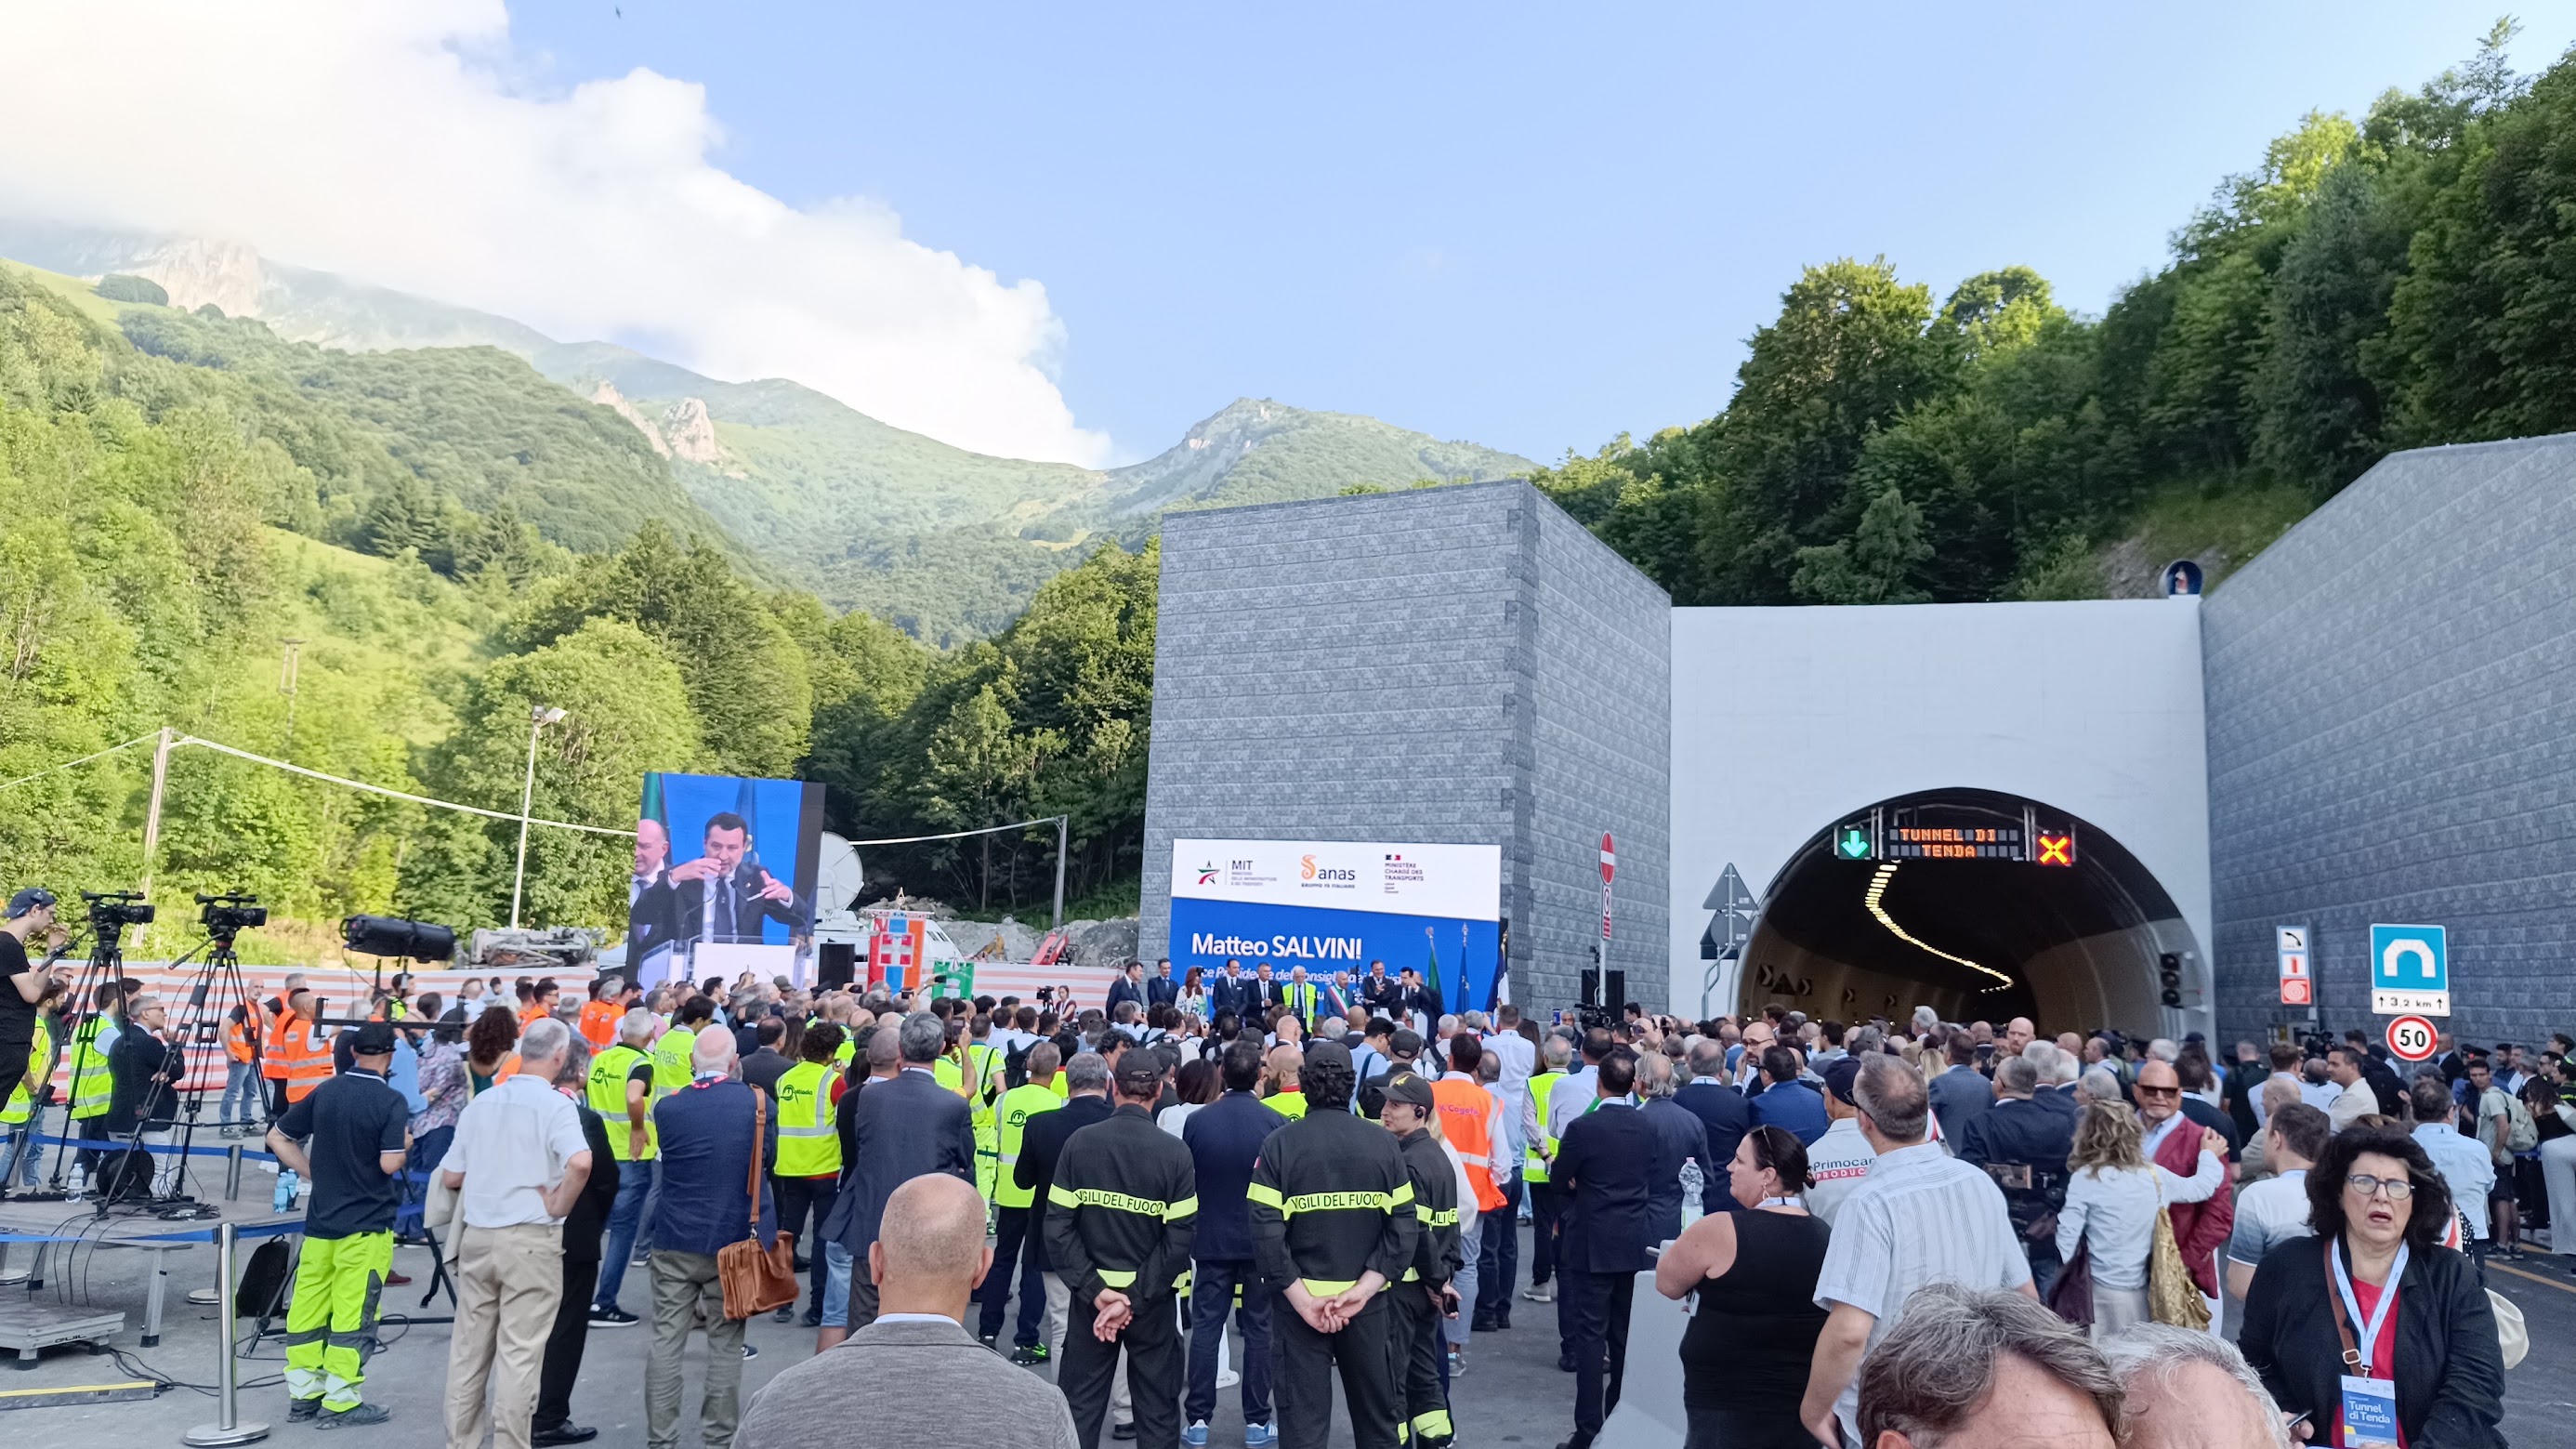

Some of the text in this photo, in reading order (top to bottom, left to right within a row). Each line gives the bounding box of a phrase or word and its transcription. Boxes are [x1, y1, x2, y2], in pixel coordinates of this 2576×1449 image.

[1899, 829, 1996, 842] TUNNEL DI
[1922, 845, 1977, 857] TENDA
[1231, 860, 1253, 870] MIT
[1191, 932, 1268, 956] Matteo
[2415, 999, 2432, 1008] km
[2399, 1029, 2426, 1047] 50
[1816, 1167, 1866, 1180] PRODUC
[1103, 1193, 1124, 1206] DEL
[1324, 1194, 1345, 1207] DEL
[2348, 1400, 2383, 1414] Tunnel
[2348, 1410, 2391, 1424] di Tenda
